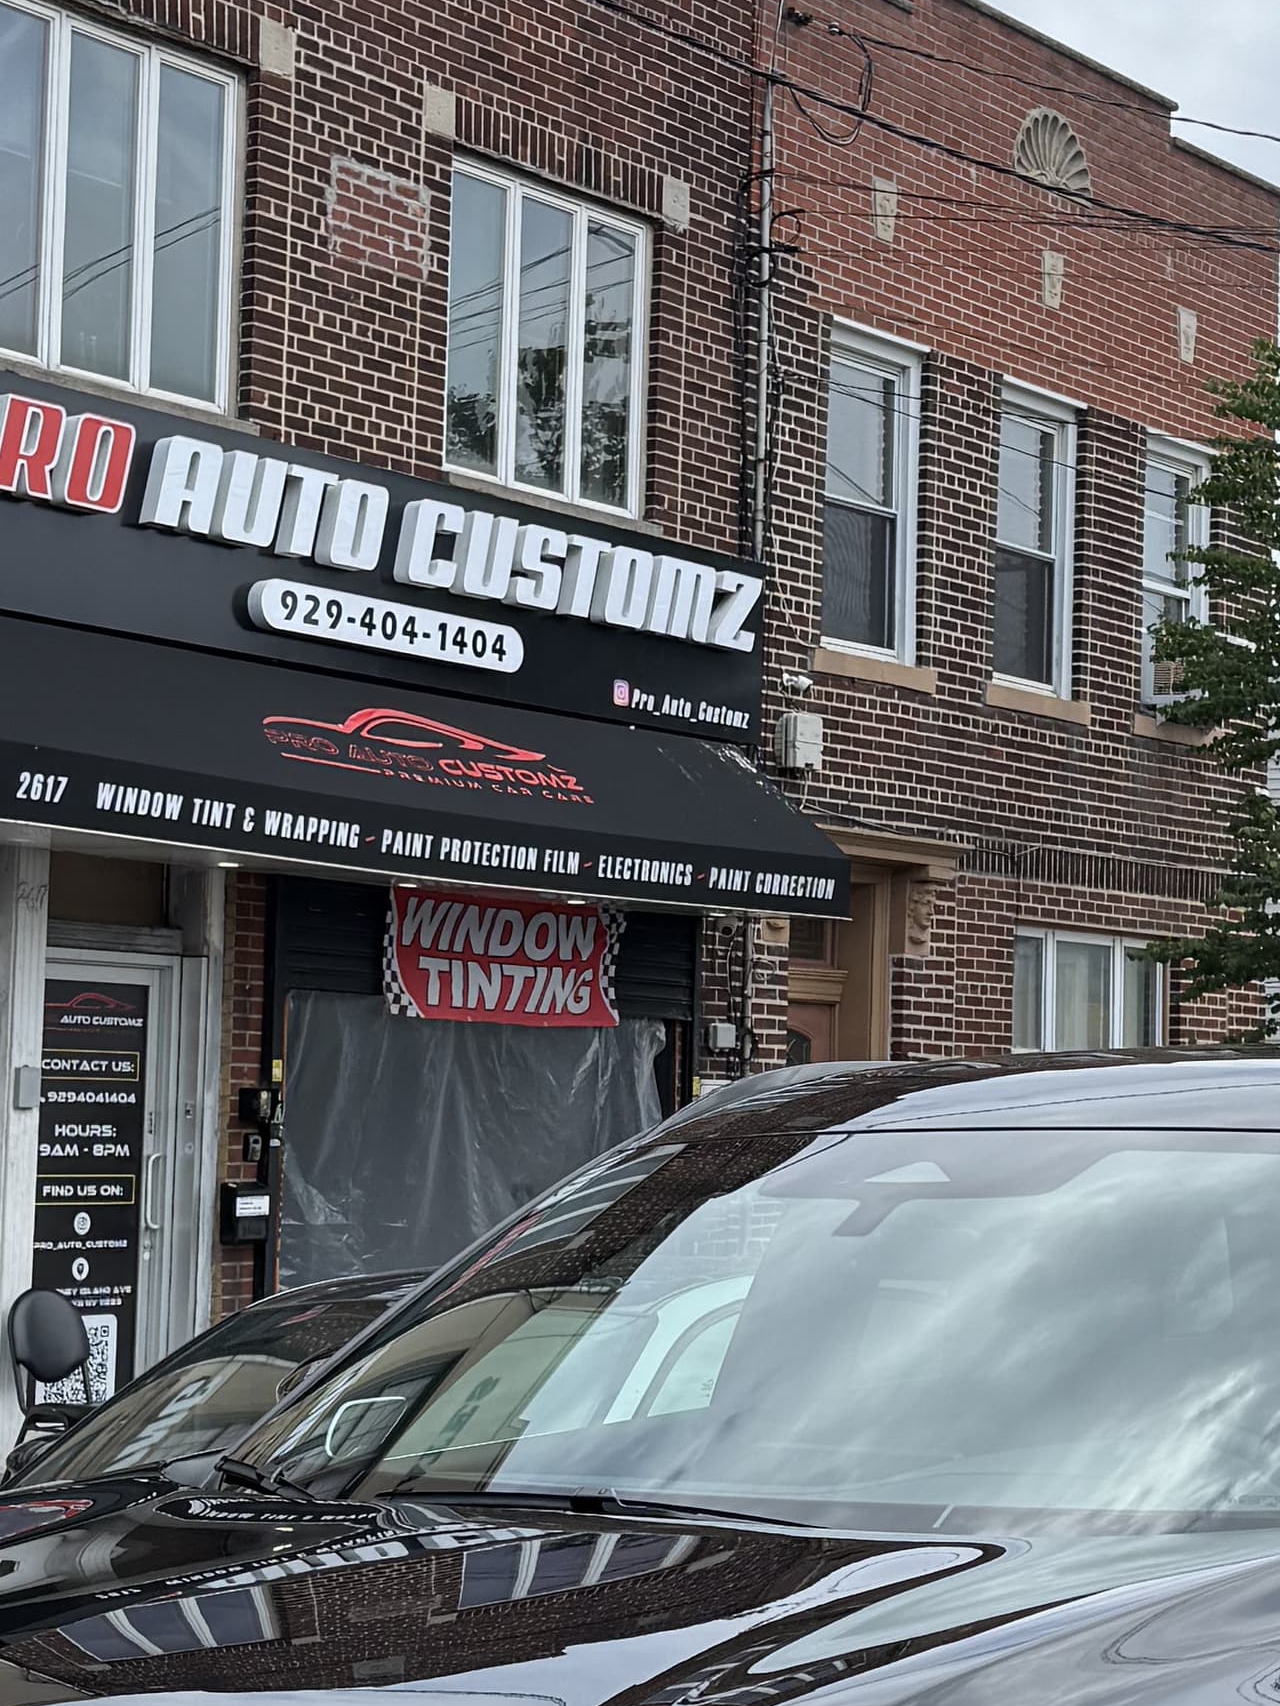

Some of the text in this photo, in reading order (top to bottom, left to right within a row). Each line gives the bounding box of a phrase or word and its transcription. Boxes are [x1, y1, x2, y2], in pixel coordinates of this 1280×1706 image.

[139, 435, 390, 572] AUTO
[394, 497, 764, 653] CUSTOMZ
[280, 590, 508, 662] 929-404-1404
[631, 688, 750, 729] Pro_Auto_Customz
[264, 728, 585, 791] PRO AUTO CUSTOMZ
[383, 768, 595, 805] PREMIUM CAR CARE
[16, 771, 836, 901] 2617 WINDOW TINT & WRAPPING PAINT PROTECTION FILM ELECTRONICS PAINT CORRECTION
[401, 896, 598, 962] WINDOW
[417, 956, 594, 1015] TINTING
[60, 1015, 144, 1027] AUTO CUSTOMZ
[41, 1059, 135, 1072] CONTACT US:
[47, 1091, 136, 1104] 9294041404
[54, 1124, 117, 1137] HOURS:
[39, 1144, 79, 1157] 9AM
[92, 1144, 130, 1157] 8PM
[42, 1185, 124, 1197] FIND US ON:
